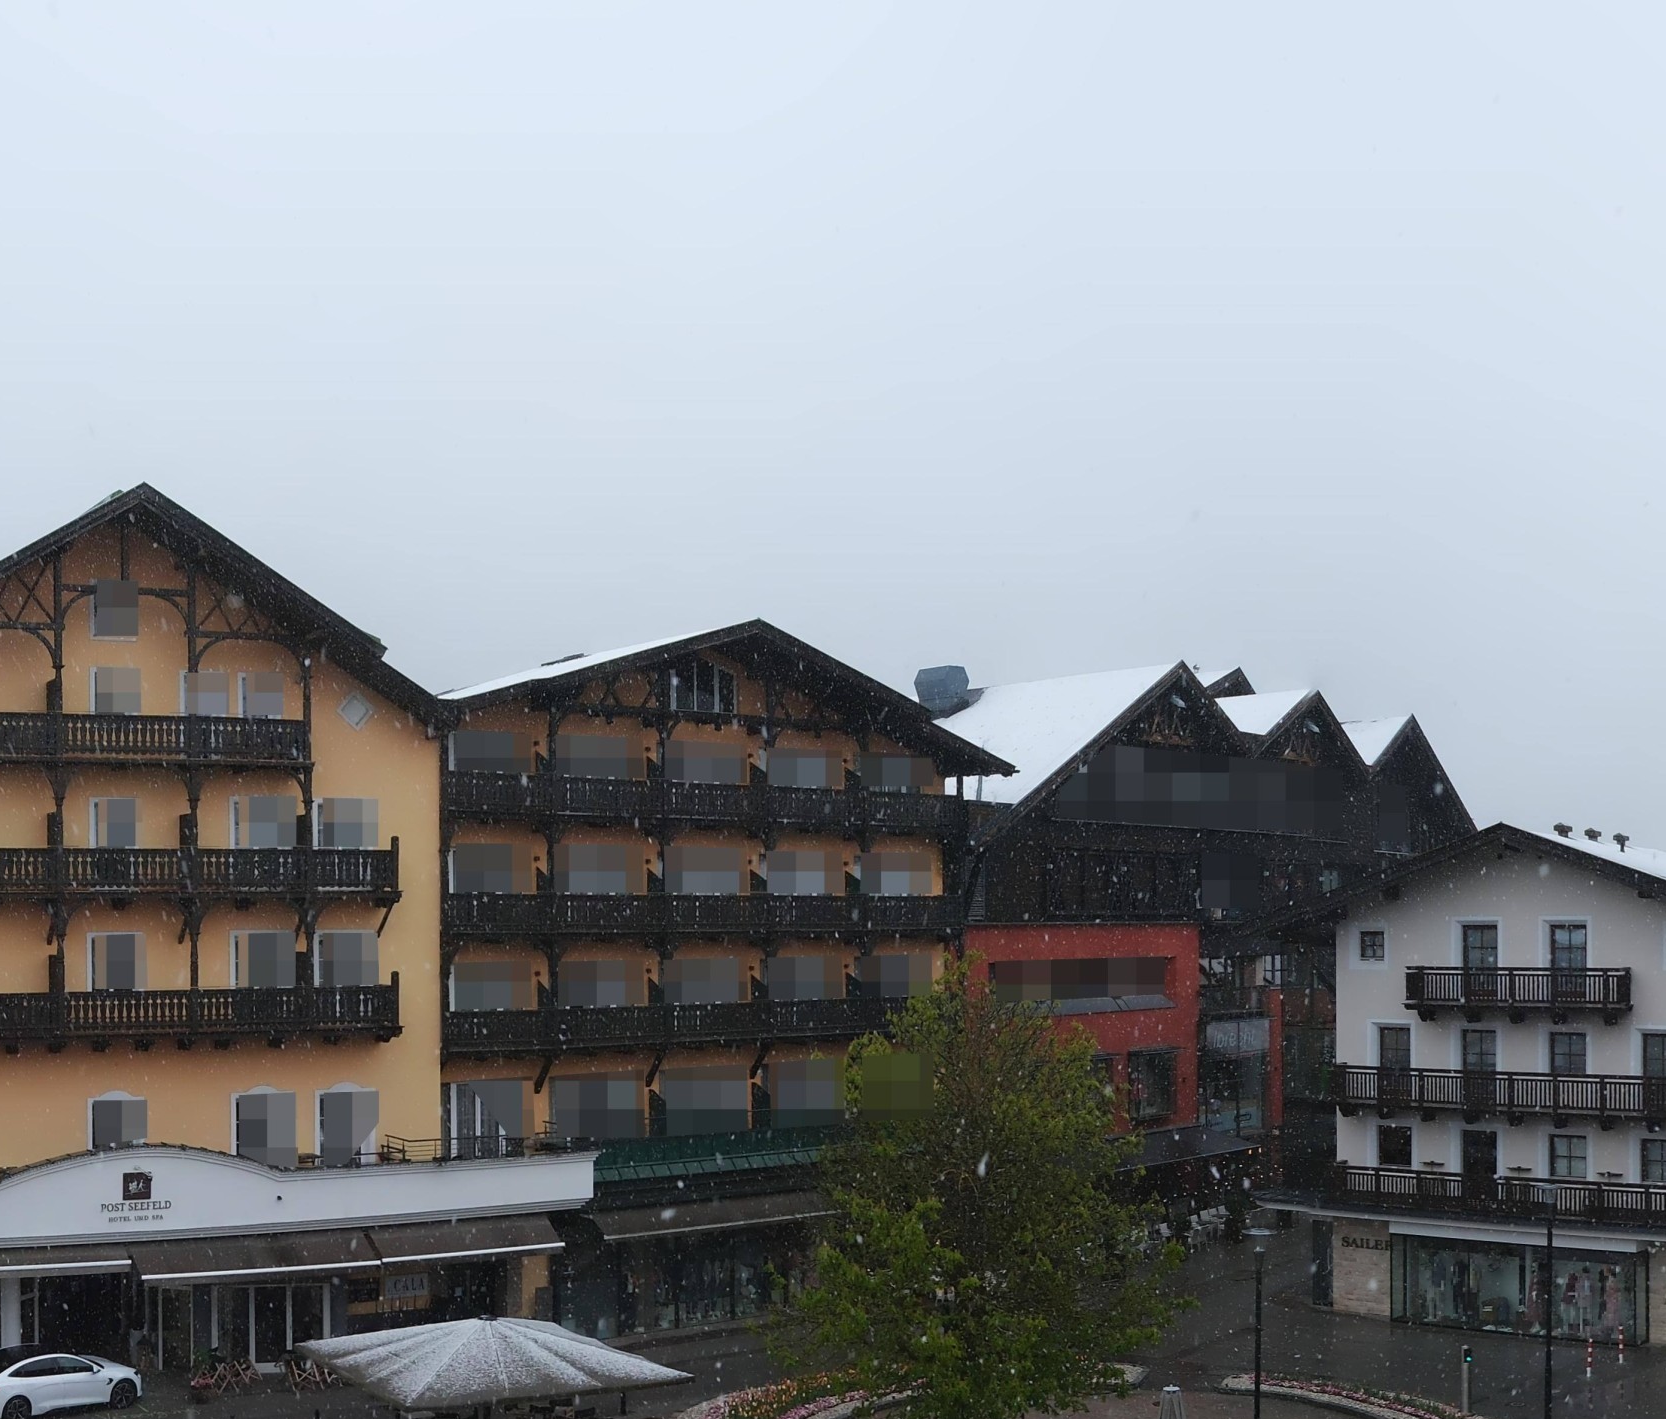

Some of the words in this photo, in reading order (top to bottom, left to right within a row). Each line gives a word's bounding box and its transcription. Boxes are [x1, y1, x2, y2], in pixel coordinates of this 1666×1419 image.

[101, 1203, 126, 1213] POST
[128, 1200, 172, 1211] SEEFELD
[109, 1215, 131, 1223] HOTEL
